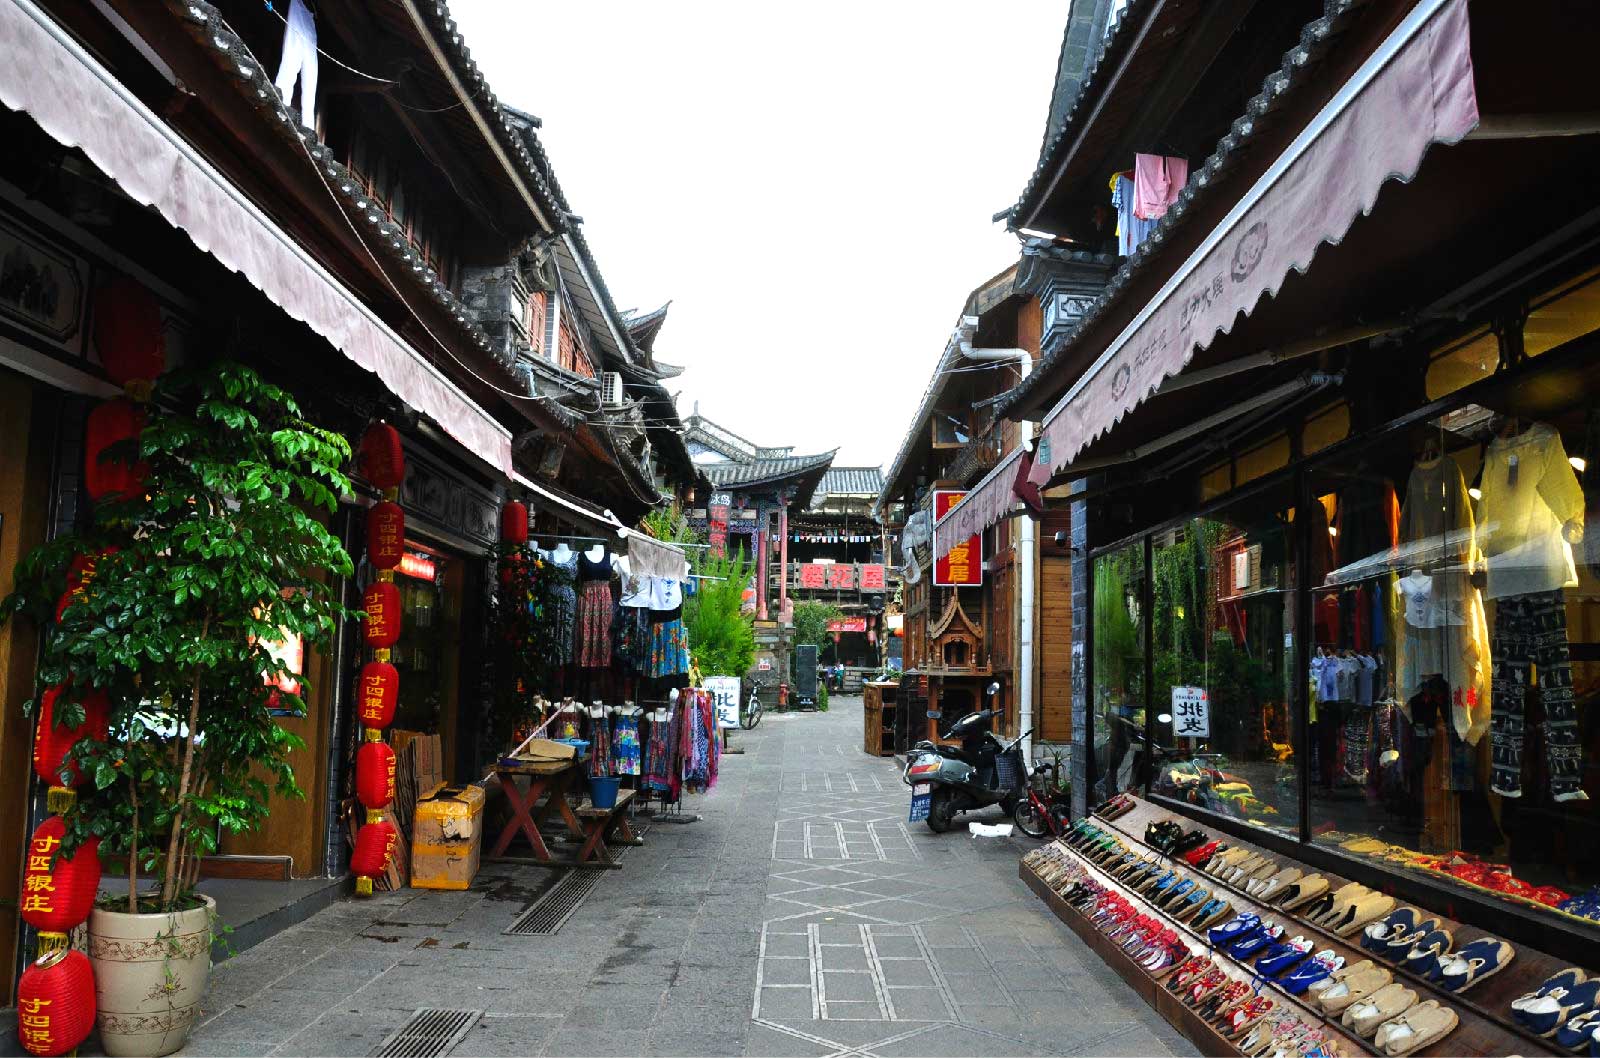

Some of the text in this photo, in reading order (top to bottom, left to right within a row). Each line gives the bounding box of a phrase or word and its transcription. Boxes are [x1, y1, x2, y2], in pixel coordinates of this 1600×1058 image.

[365, 593, 388, 637] 寸四银庄
[363, 675, 387, 721] 寸四银庄
[22, 835, 61, 913] 寸四银庄
